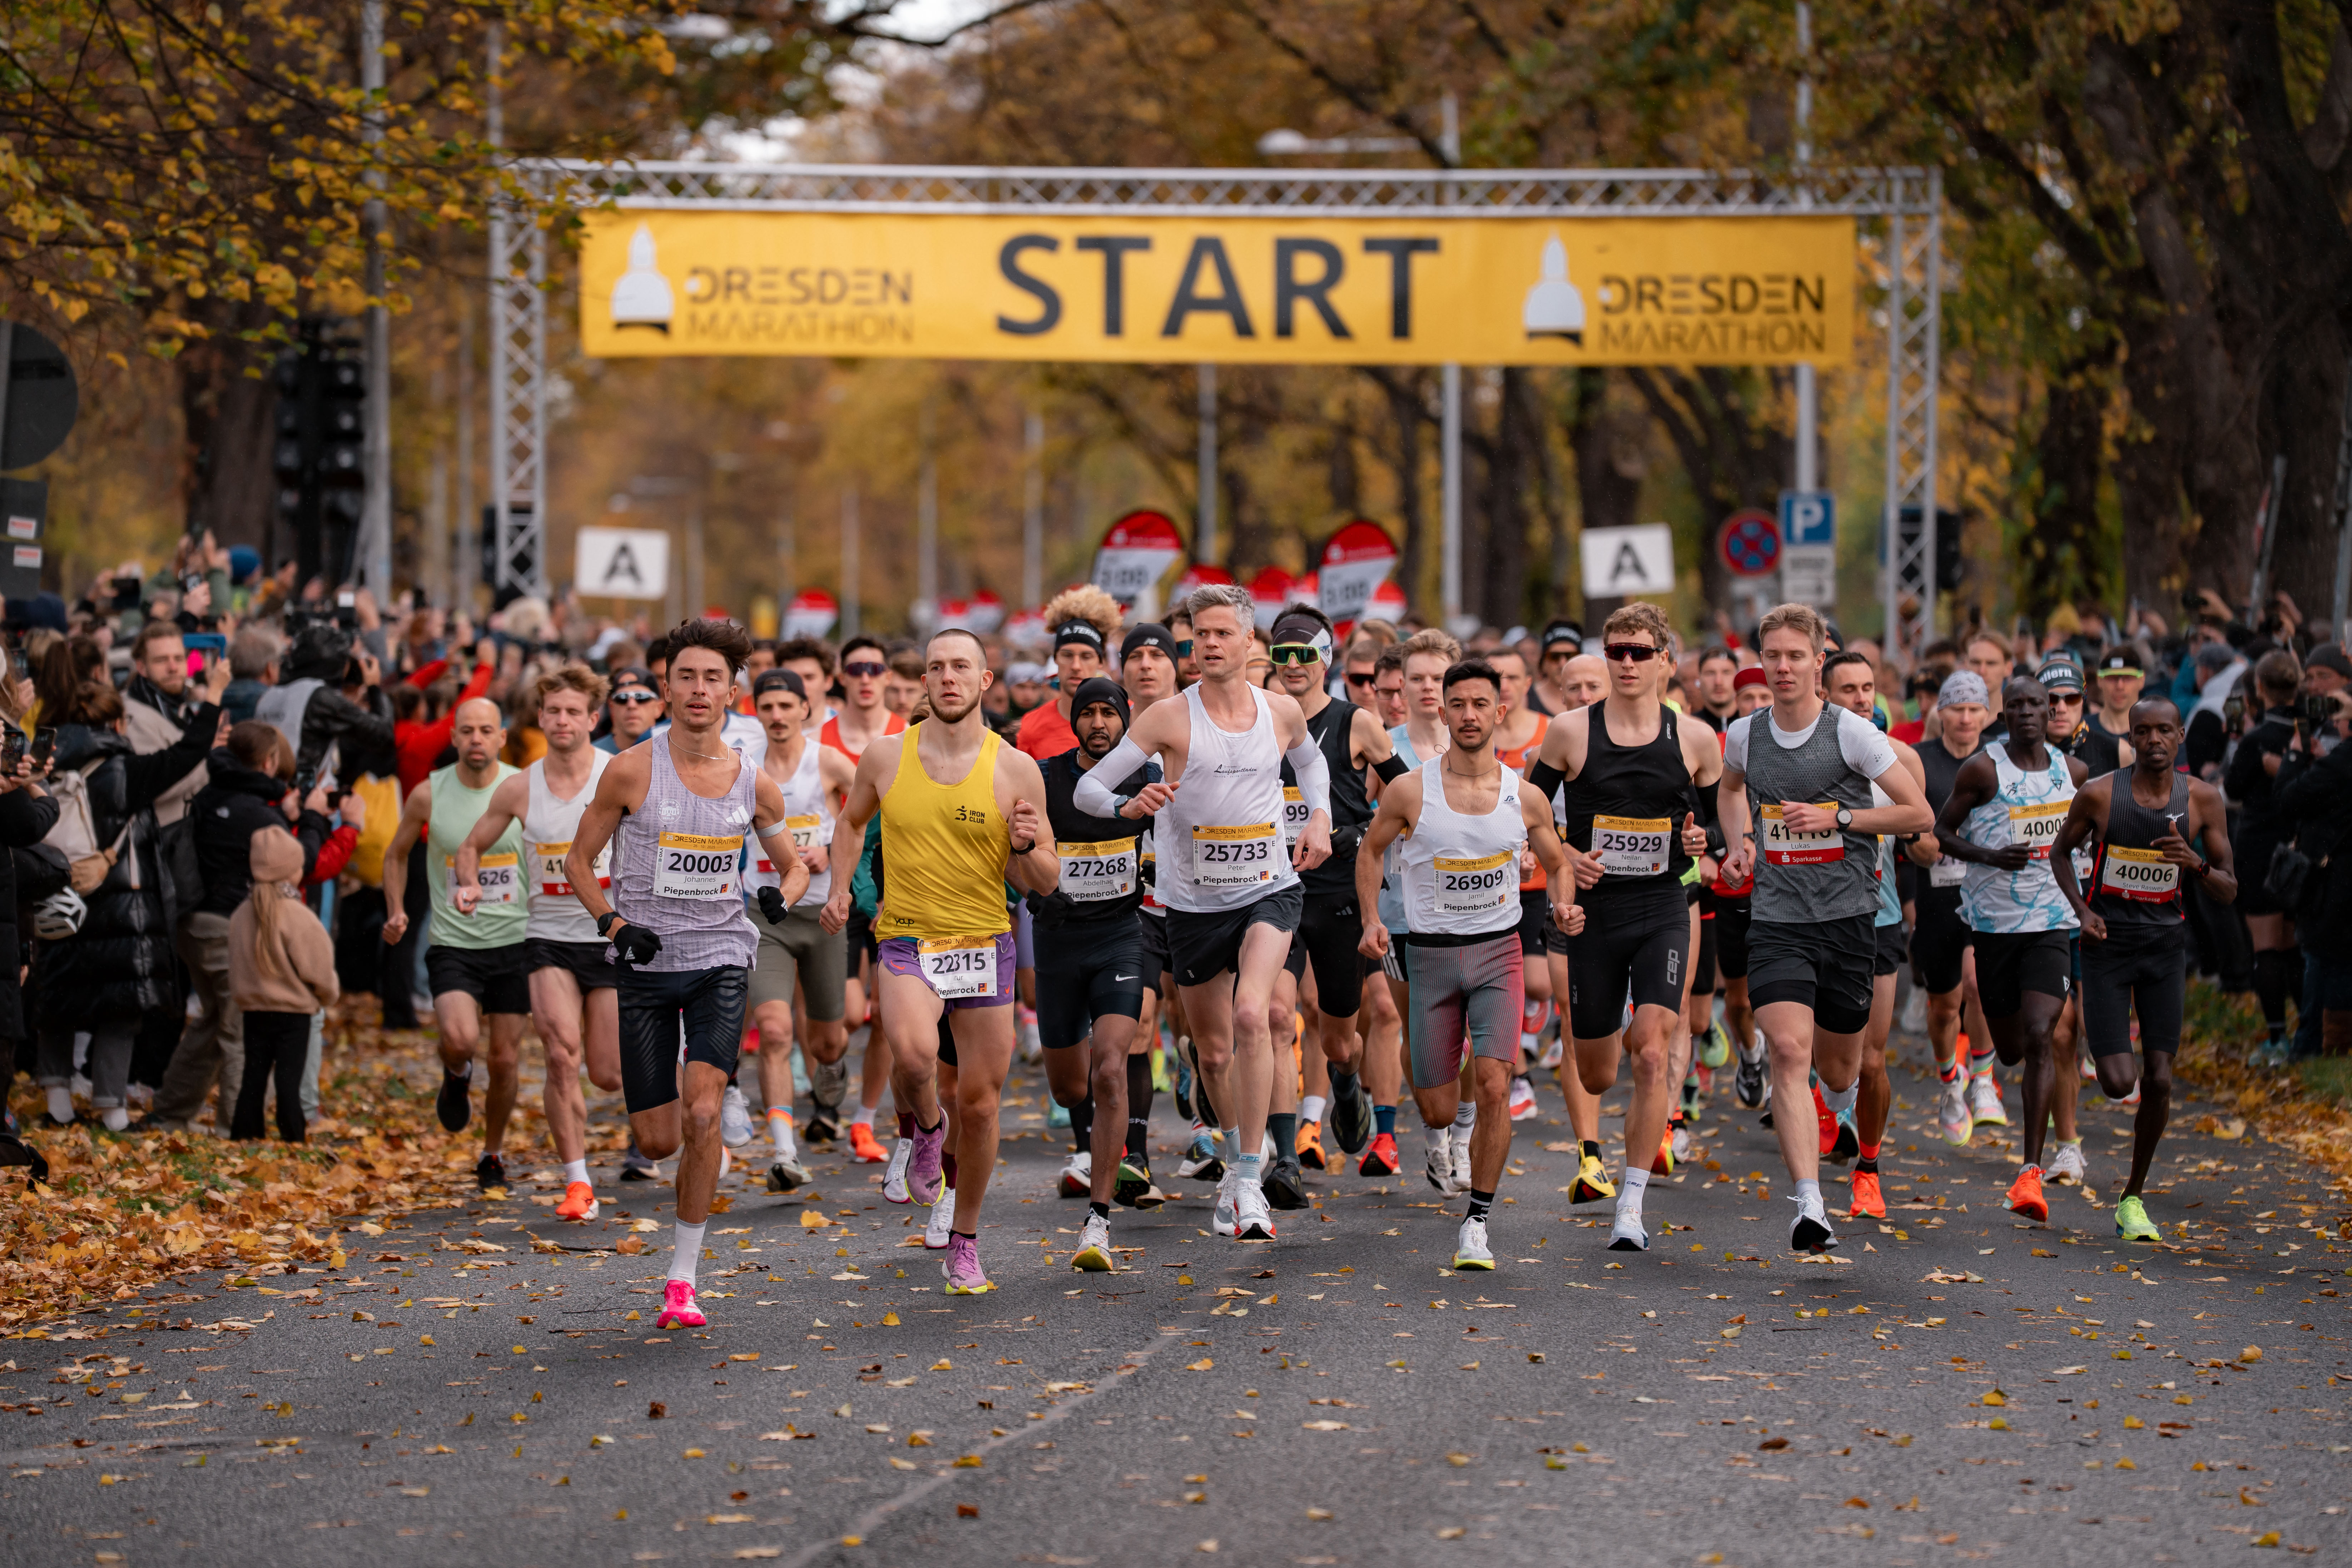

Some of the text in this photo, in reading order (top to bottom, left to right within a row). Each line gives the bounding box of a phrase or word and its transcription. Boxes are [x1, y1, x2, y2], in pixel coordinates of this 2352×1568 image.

[688, 266, 913, 304] DRESDEN
[996, 234, 1440, 339] START
[1599, 274, 1826, 315] DRESDEN
[686, 311, 914, 342] MARATHON
[1598, 320, 1826, 353] MARATHON
[1791, 500, 1825, 544] P
[604, 542, 641, 584] A
[1609, 540, 1648, 580] A
[1214, 764, 1257, 775] Laufsportladen
[1238, 825, 1271, 834] MARATHON
[1099, 839, 1130, 849] MARATHON
[1204, 842, 1267, 862] 25733
[1602, 834, 1662, 852] 25929
[668, 852, 733, 873] 20003
[1068, 857, 1126, 877] 27268
[1478, 852, 1508, 865] MARATHON
[1204, 875, 1258, 885] Piepenbrock
[1446, 870, 1503, 890] 26909
[2115, 865, 2173, 883] 40006
[664, 887, 719, 896] Piepenbrock
[1067, 889, 1120, 899] Piepenbrock
[1444, 901, 1497, 912] Piepenbrock
[932, 938, 960, 947] DRESDEN
[932, 953, 986, 974] 22315
[1667, 949, 1680, 986] cep
